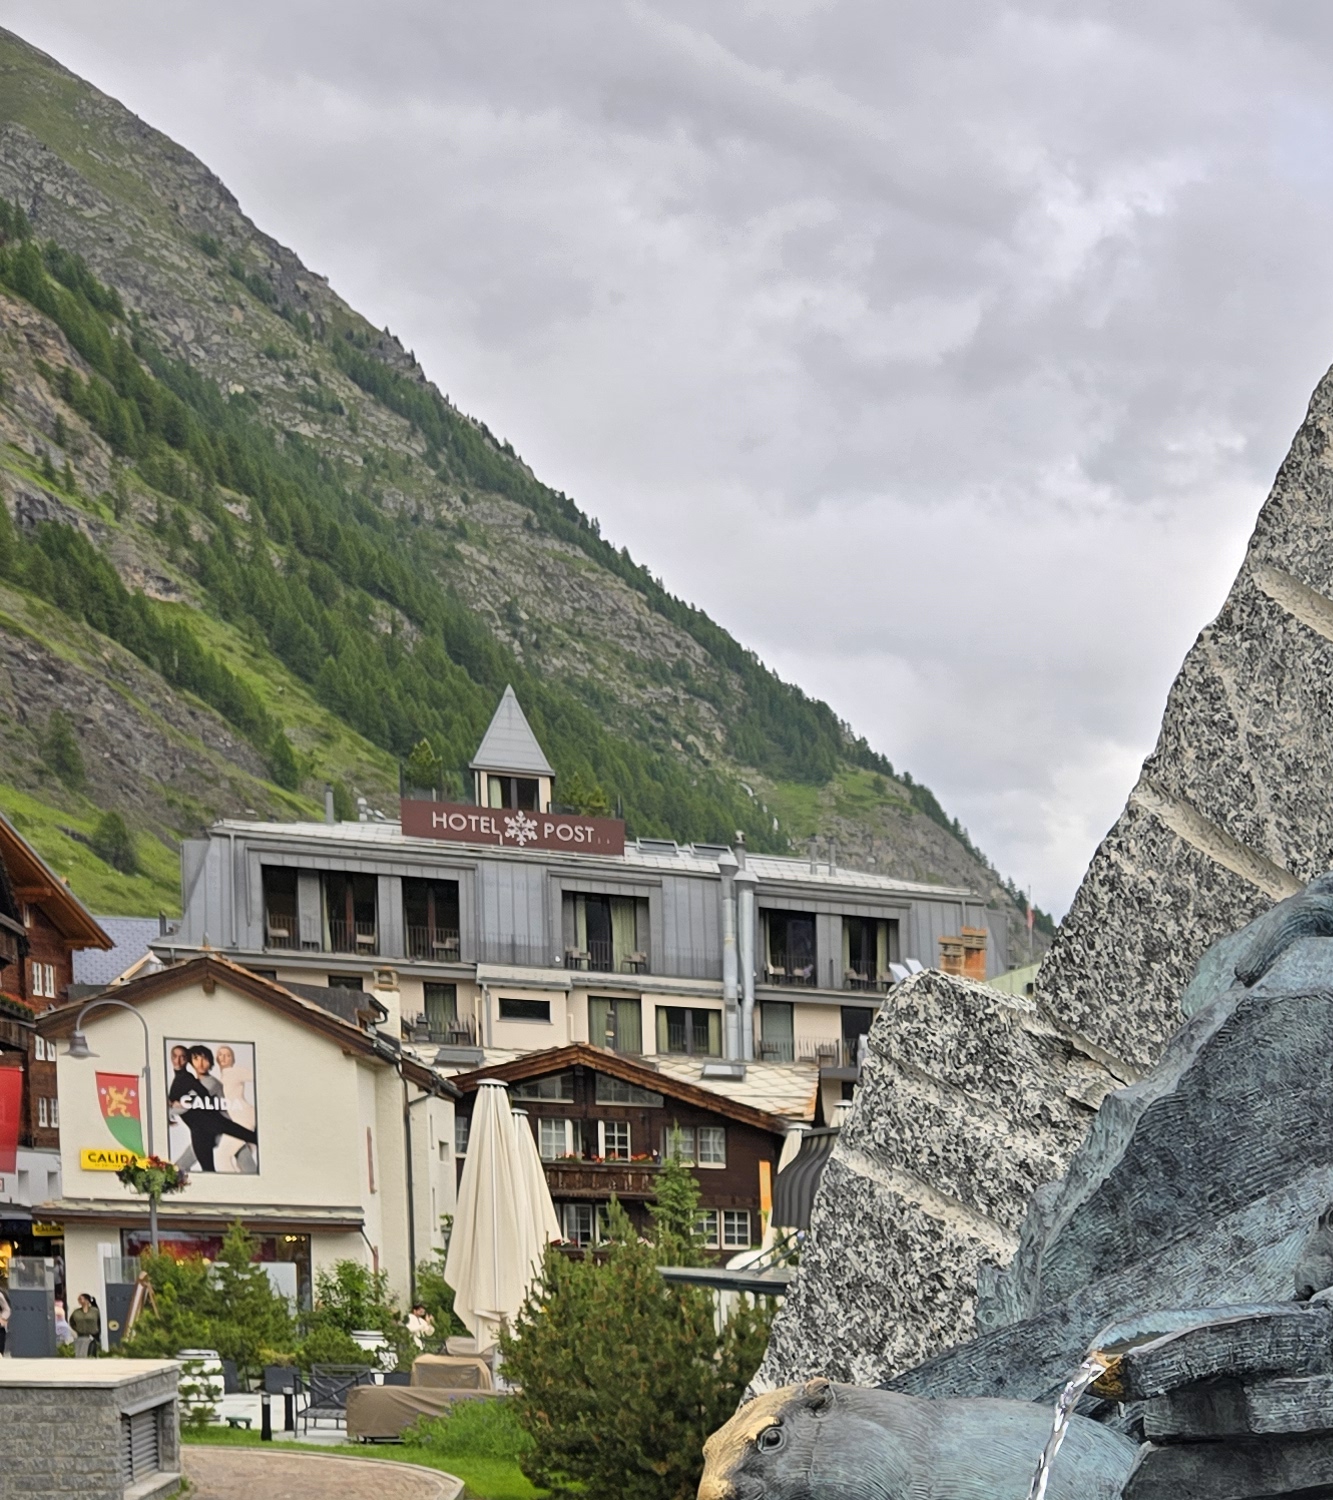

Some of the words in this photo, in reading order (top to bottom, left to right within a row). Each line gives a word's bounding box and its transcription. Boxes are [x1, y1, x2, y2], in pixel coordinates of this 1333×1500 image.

[432, 811, 501, 837] HOTEL
[543, 821, 595, 843] POST
[180, 1094, 244, 1111] CALIDA
[87, 1153, 138, 1164] CALIDA
